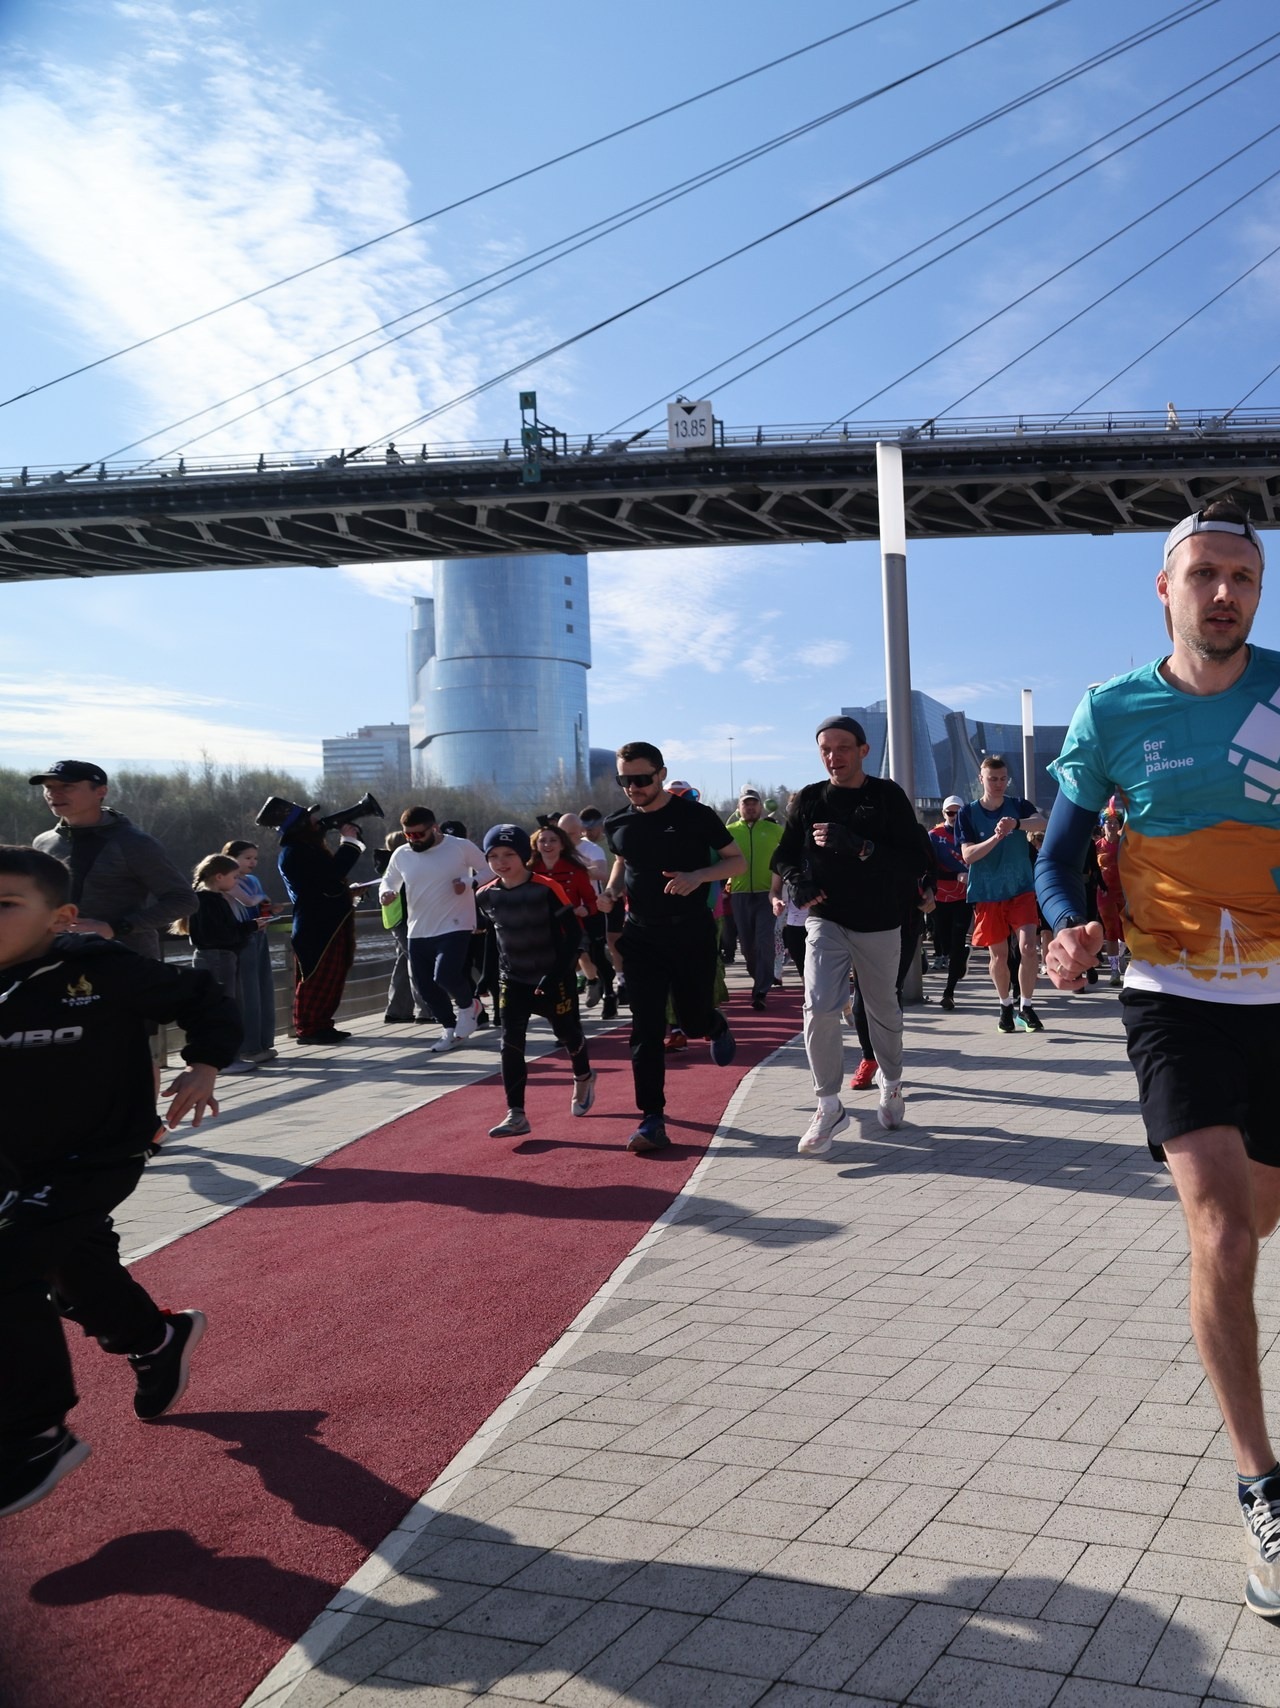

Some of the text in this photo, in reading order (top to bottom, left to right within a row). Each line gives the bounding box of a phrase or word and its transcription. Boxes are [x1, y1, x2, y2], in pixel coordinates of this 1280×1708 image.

[675, 419, 706, 438] 13.85
[1143, 739, 1166, 752] бег
[1144, 751, 1161, 762] на
[1146, 757, 1194, 777] районе
